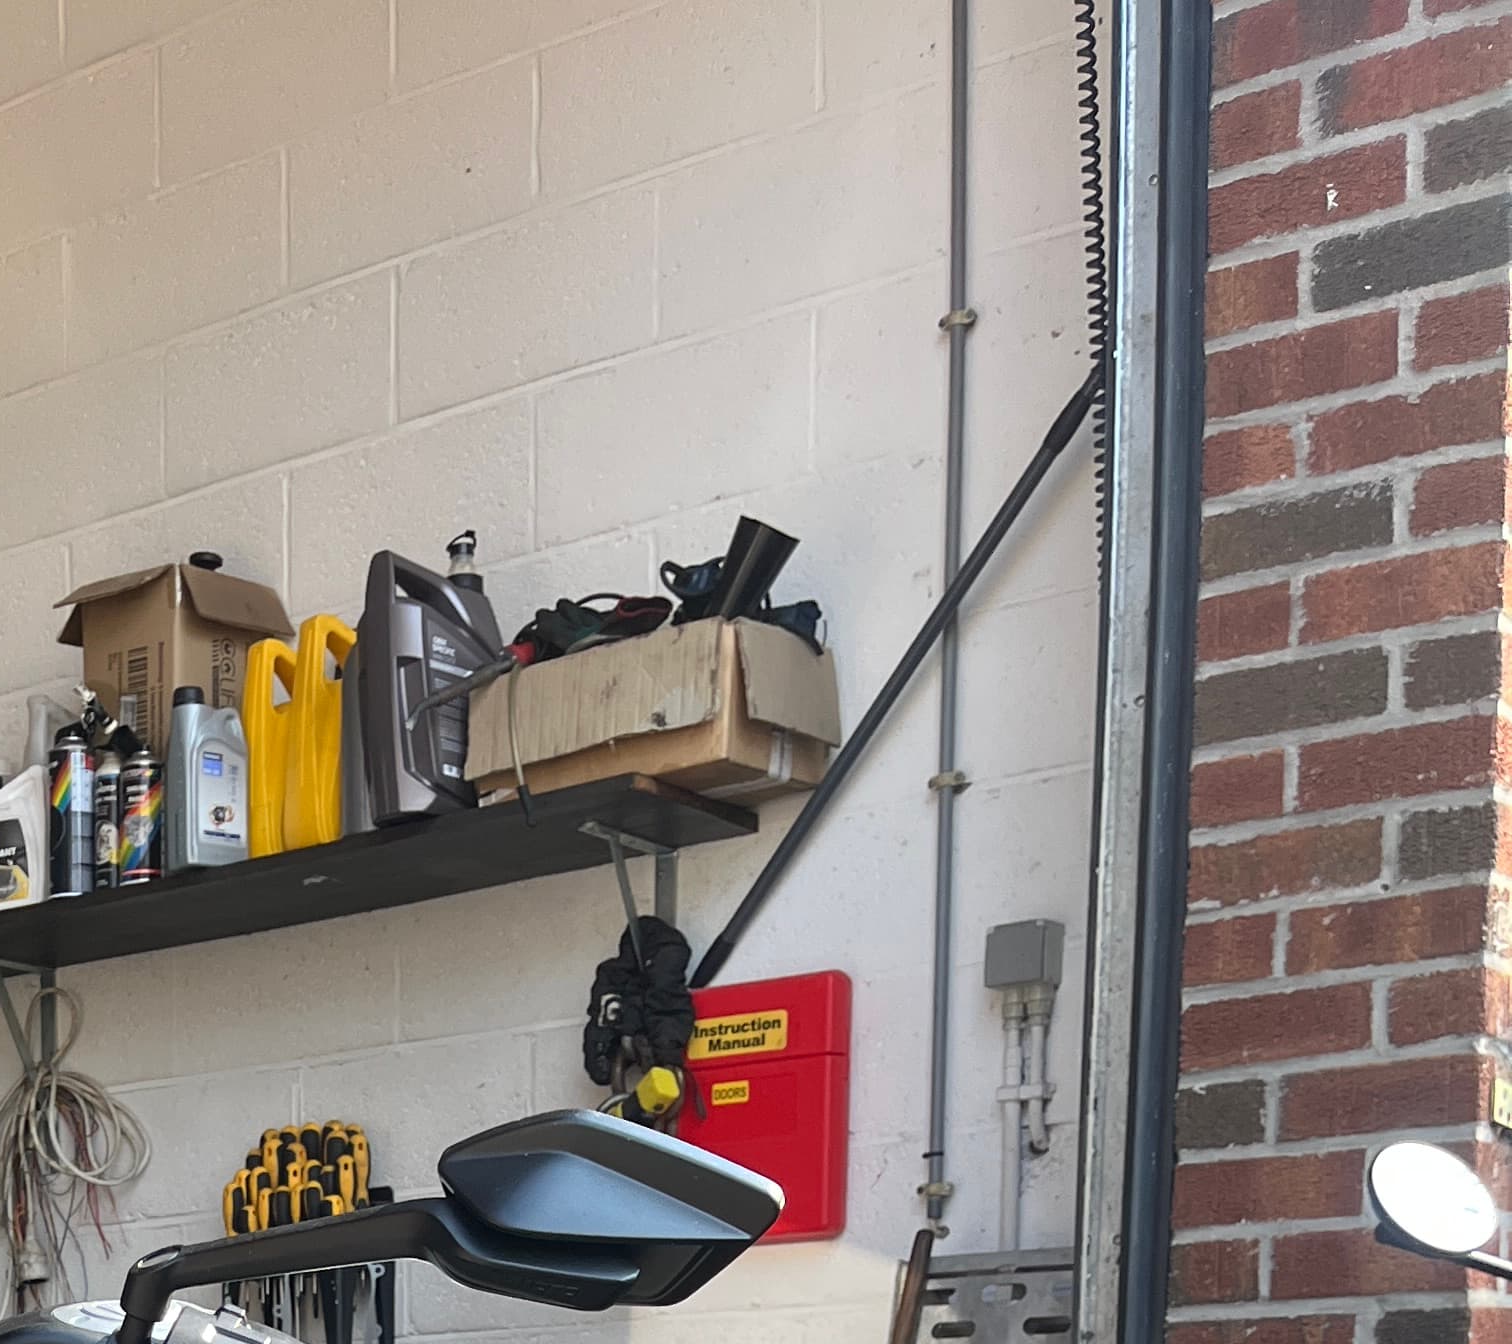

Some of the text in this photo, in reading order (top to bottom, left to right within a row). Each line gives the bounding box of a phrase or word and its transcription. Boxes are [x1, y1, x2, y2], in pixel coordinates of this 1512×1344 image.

[693, 1017, 782, 1039] Instruction
[708, 1033, 766, 1052] Manual
[714, 1087, 747, 1101] DOORS
